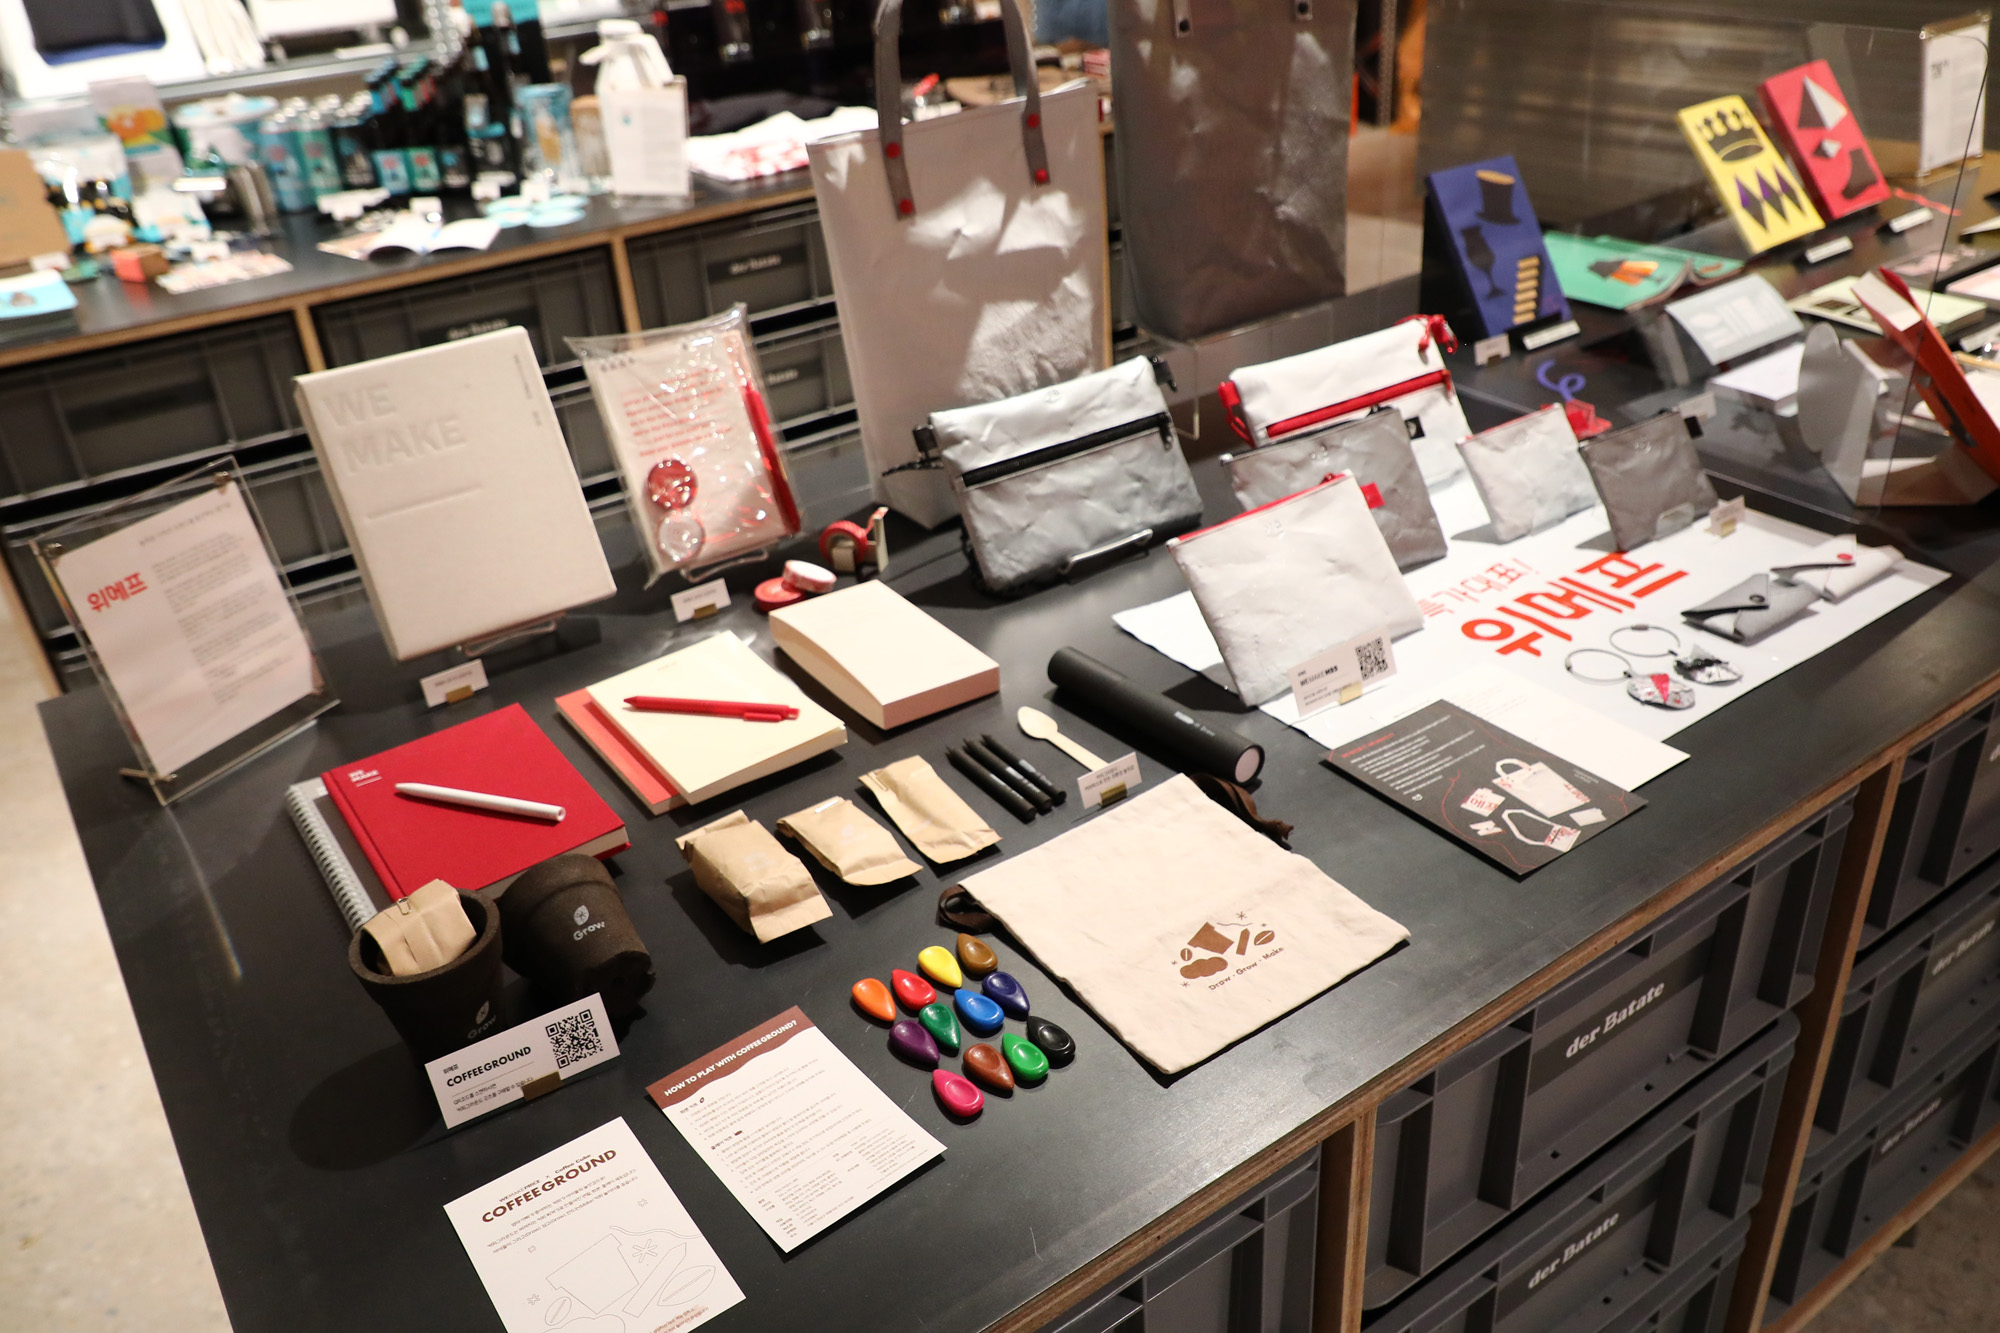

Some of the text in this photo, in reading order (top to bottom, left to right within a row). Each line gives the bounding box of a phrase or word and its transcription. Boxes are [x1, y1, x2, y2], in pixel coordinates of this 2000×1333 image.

[322, 383, 395, 426] WE
[342, 413, 467, 474] MAKE
[87, 572, 147, 612] 위메프
[1460, 552, 1690, 657] 위메프
[573, 921, 605, 941] Grow
[1208, 947, 1284, 991] Draw Grow Make
[467, 1014, 498, 1040] Grow
[1566, 982, 1664, 1058] der Batate
[446, 1046, 531, 1087] COFFEEGROUND
[664, 1020, 798, 1097] HOW TO PLAY WITH COFFEEGROUND?
[554, 1160, 575, 1174] Coffee
[575, 1153, 592, 1164] Cube
[481, 1149, 617, 1223] COFFEEGROUND
[1528, 1213, 1619, 1289] der Batate
